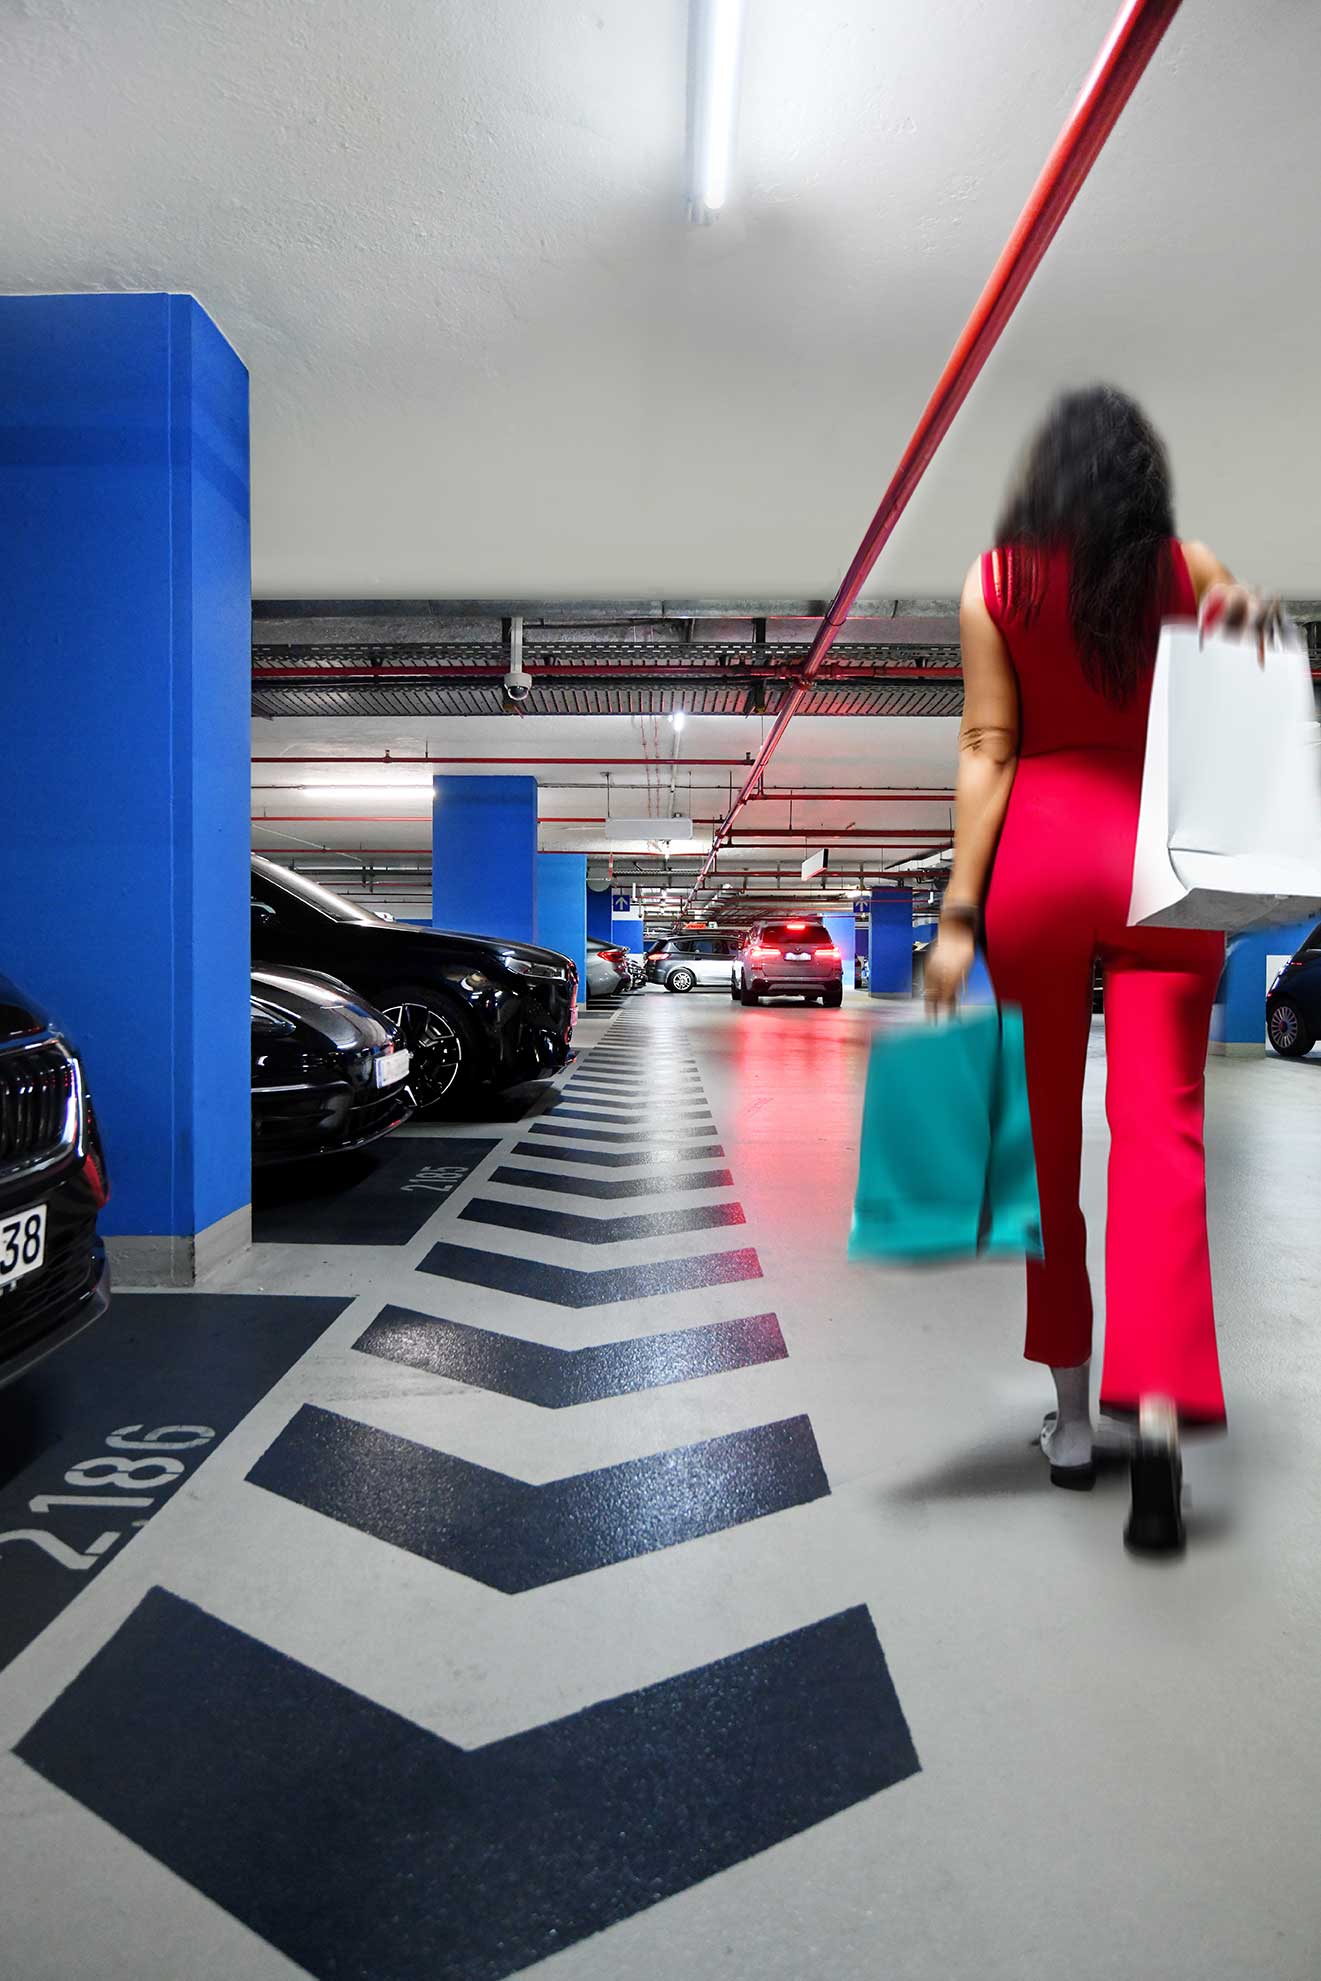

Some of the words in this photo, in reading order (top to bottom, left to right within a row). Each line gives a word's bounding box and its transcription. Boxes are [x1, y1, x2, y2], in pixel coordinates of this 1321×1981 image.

[400, 1166, 470, 1192] 2185
[0, 1208, 41, 1275] 38
[0, 1424, 216, 1570] 2186
